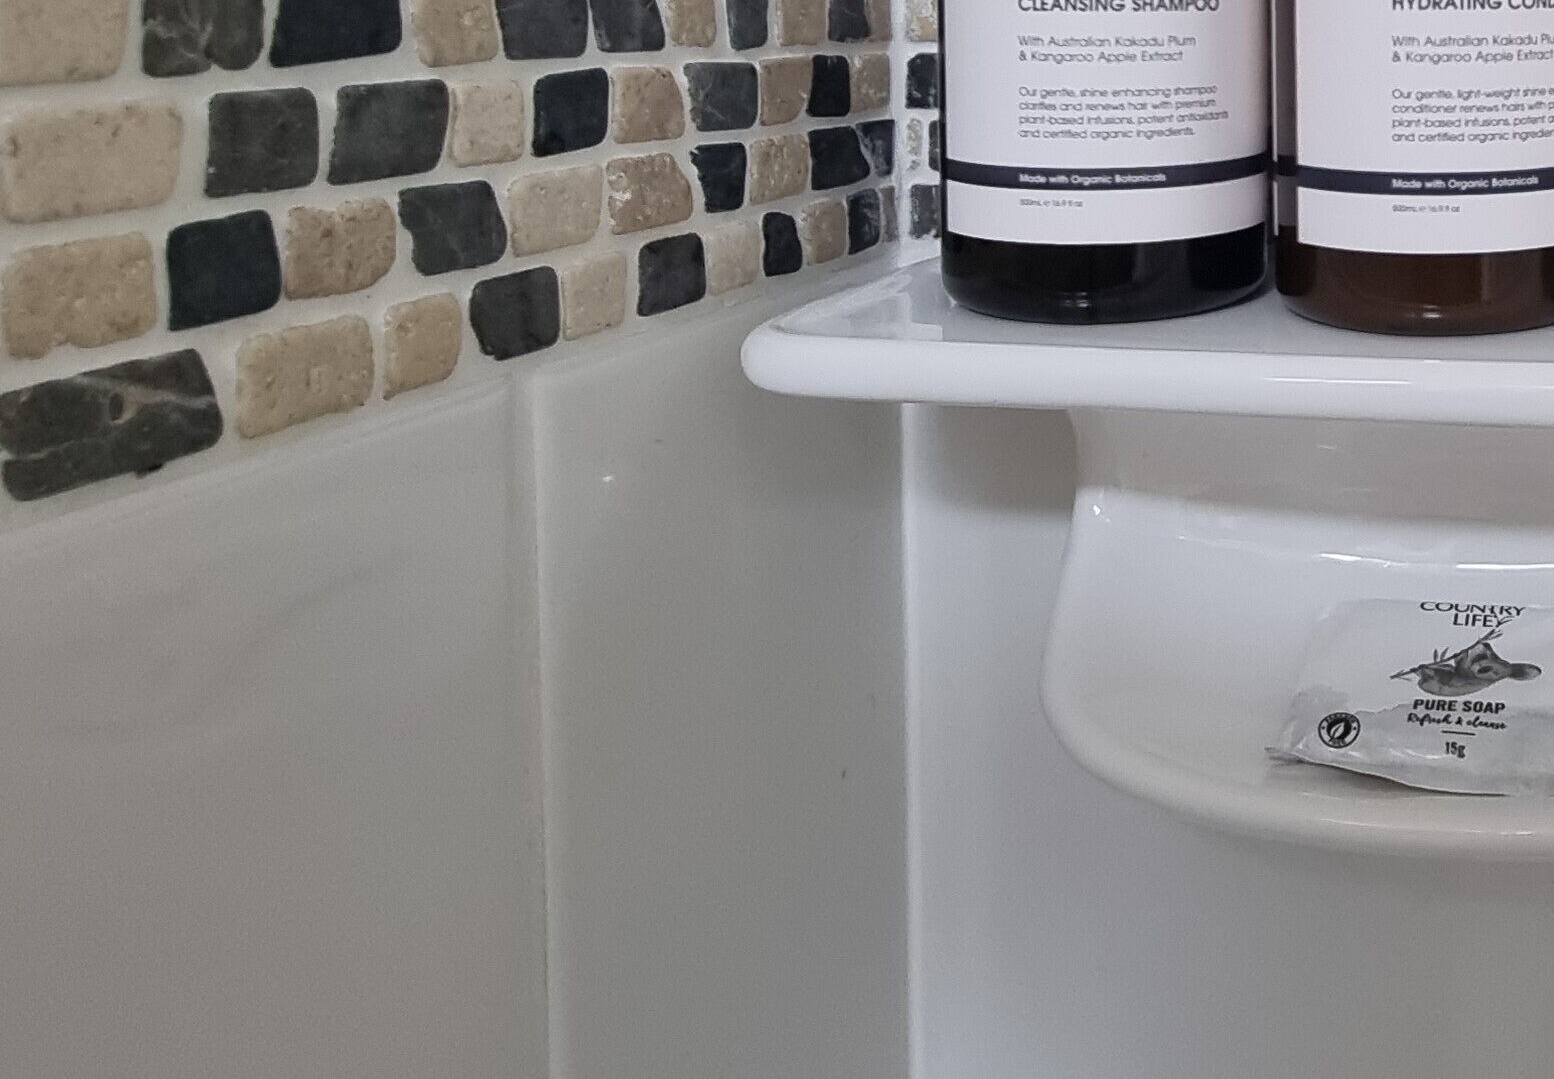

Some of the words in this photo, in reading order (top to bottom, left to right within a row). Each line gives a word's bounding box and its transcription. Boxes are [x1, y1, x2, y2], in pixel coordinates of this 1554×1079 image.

[1018, 36, 1044, 46] With
[1048, 36, 1111, 47] Australian
[1115, 36, 1164, 47] Kakadu
[1167, 36, 1196, 46] Plum
[1392, 35, 1420, 46] With
[1424, 35, 1489, 46] Australian
[1492, 34, 1538, 46] Kakadu
[1018, 51, 1027, 61] &
[1031, 51, 1094, 64] Kangaroo
[1098, 51, 1137, 63] Apple
[1141, 51, 1183, 61] Extract
[1392, 51, 1401, 62] &
[1406, 51, 1471, 65] Kangaroo
[1475, 50, 1513, 63] Apple
[1517, 49, 1554, 61] Extract
[1392, 179, 1422, 188] Made
[1425, 179, 1446, 188] with
[1448, 179, 1489, 190] Organic
[1492, 175, 1539, 187] Botanicals
[1420, 601, 1526, 616] COUNTRY
[1453, 613, 1494, 627] LIFE
[1413, 699, 1458, 711] PURE
[1462, 701, 1505, 714] SOAP
[1445, 741, 1465, 758] 15g
